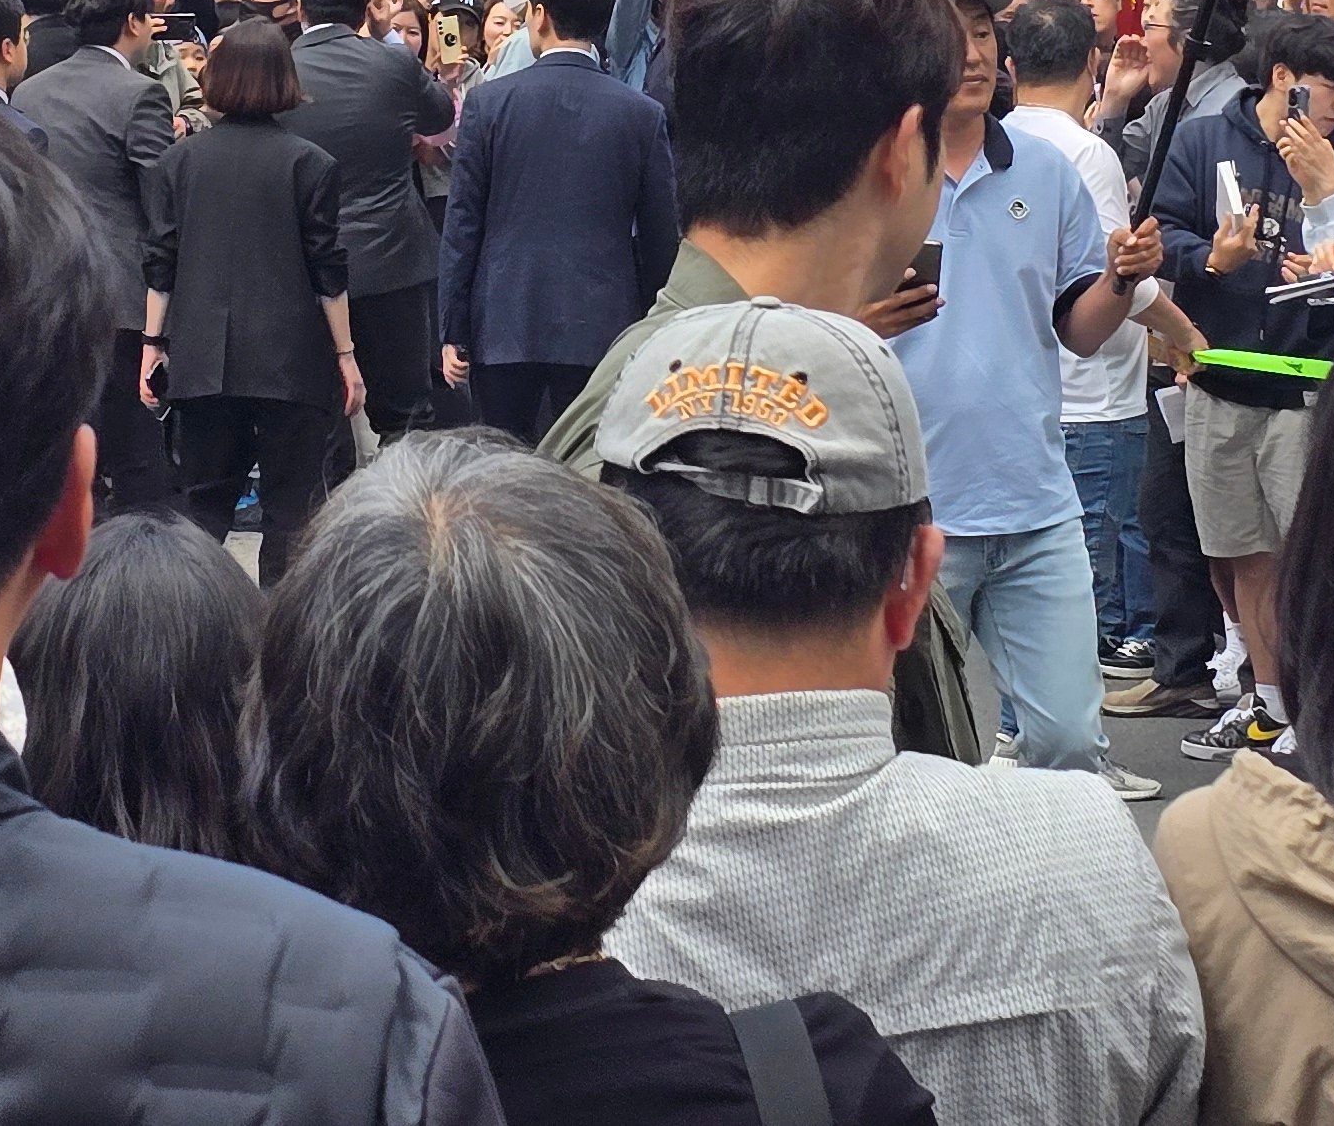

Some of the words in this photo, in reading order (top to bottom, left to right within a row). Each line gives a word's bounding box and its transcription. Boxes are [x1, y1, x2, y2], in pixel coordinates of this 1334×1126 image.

[644, 361, 829, 429] LIMITED
[675, 391, 716, 421] NY
[729, 391, 789, 426] 1953
